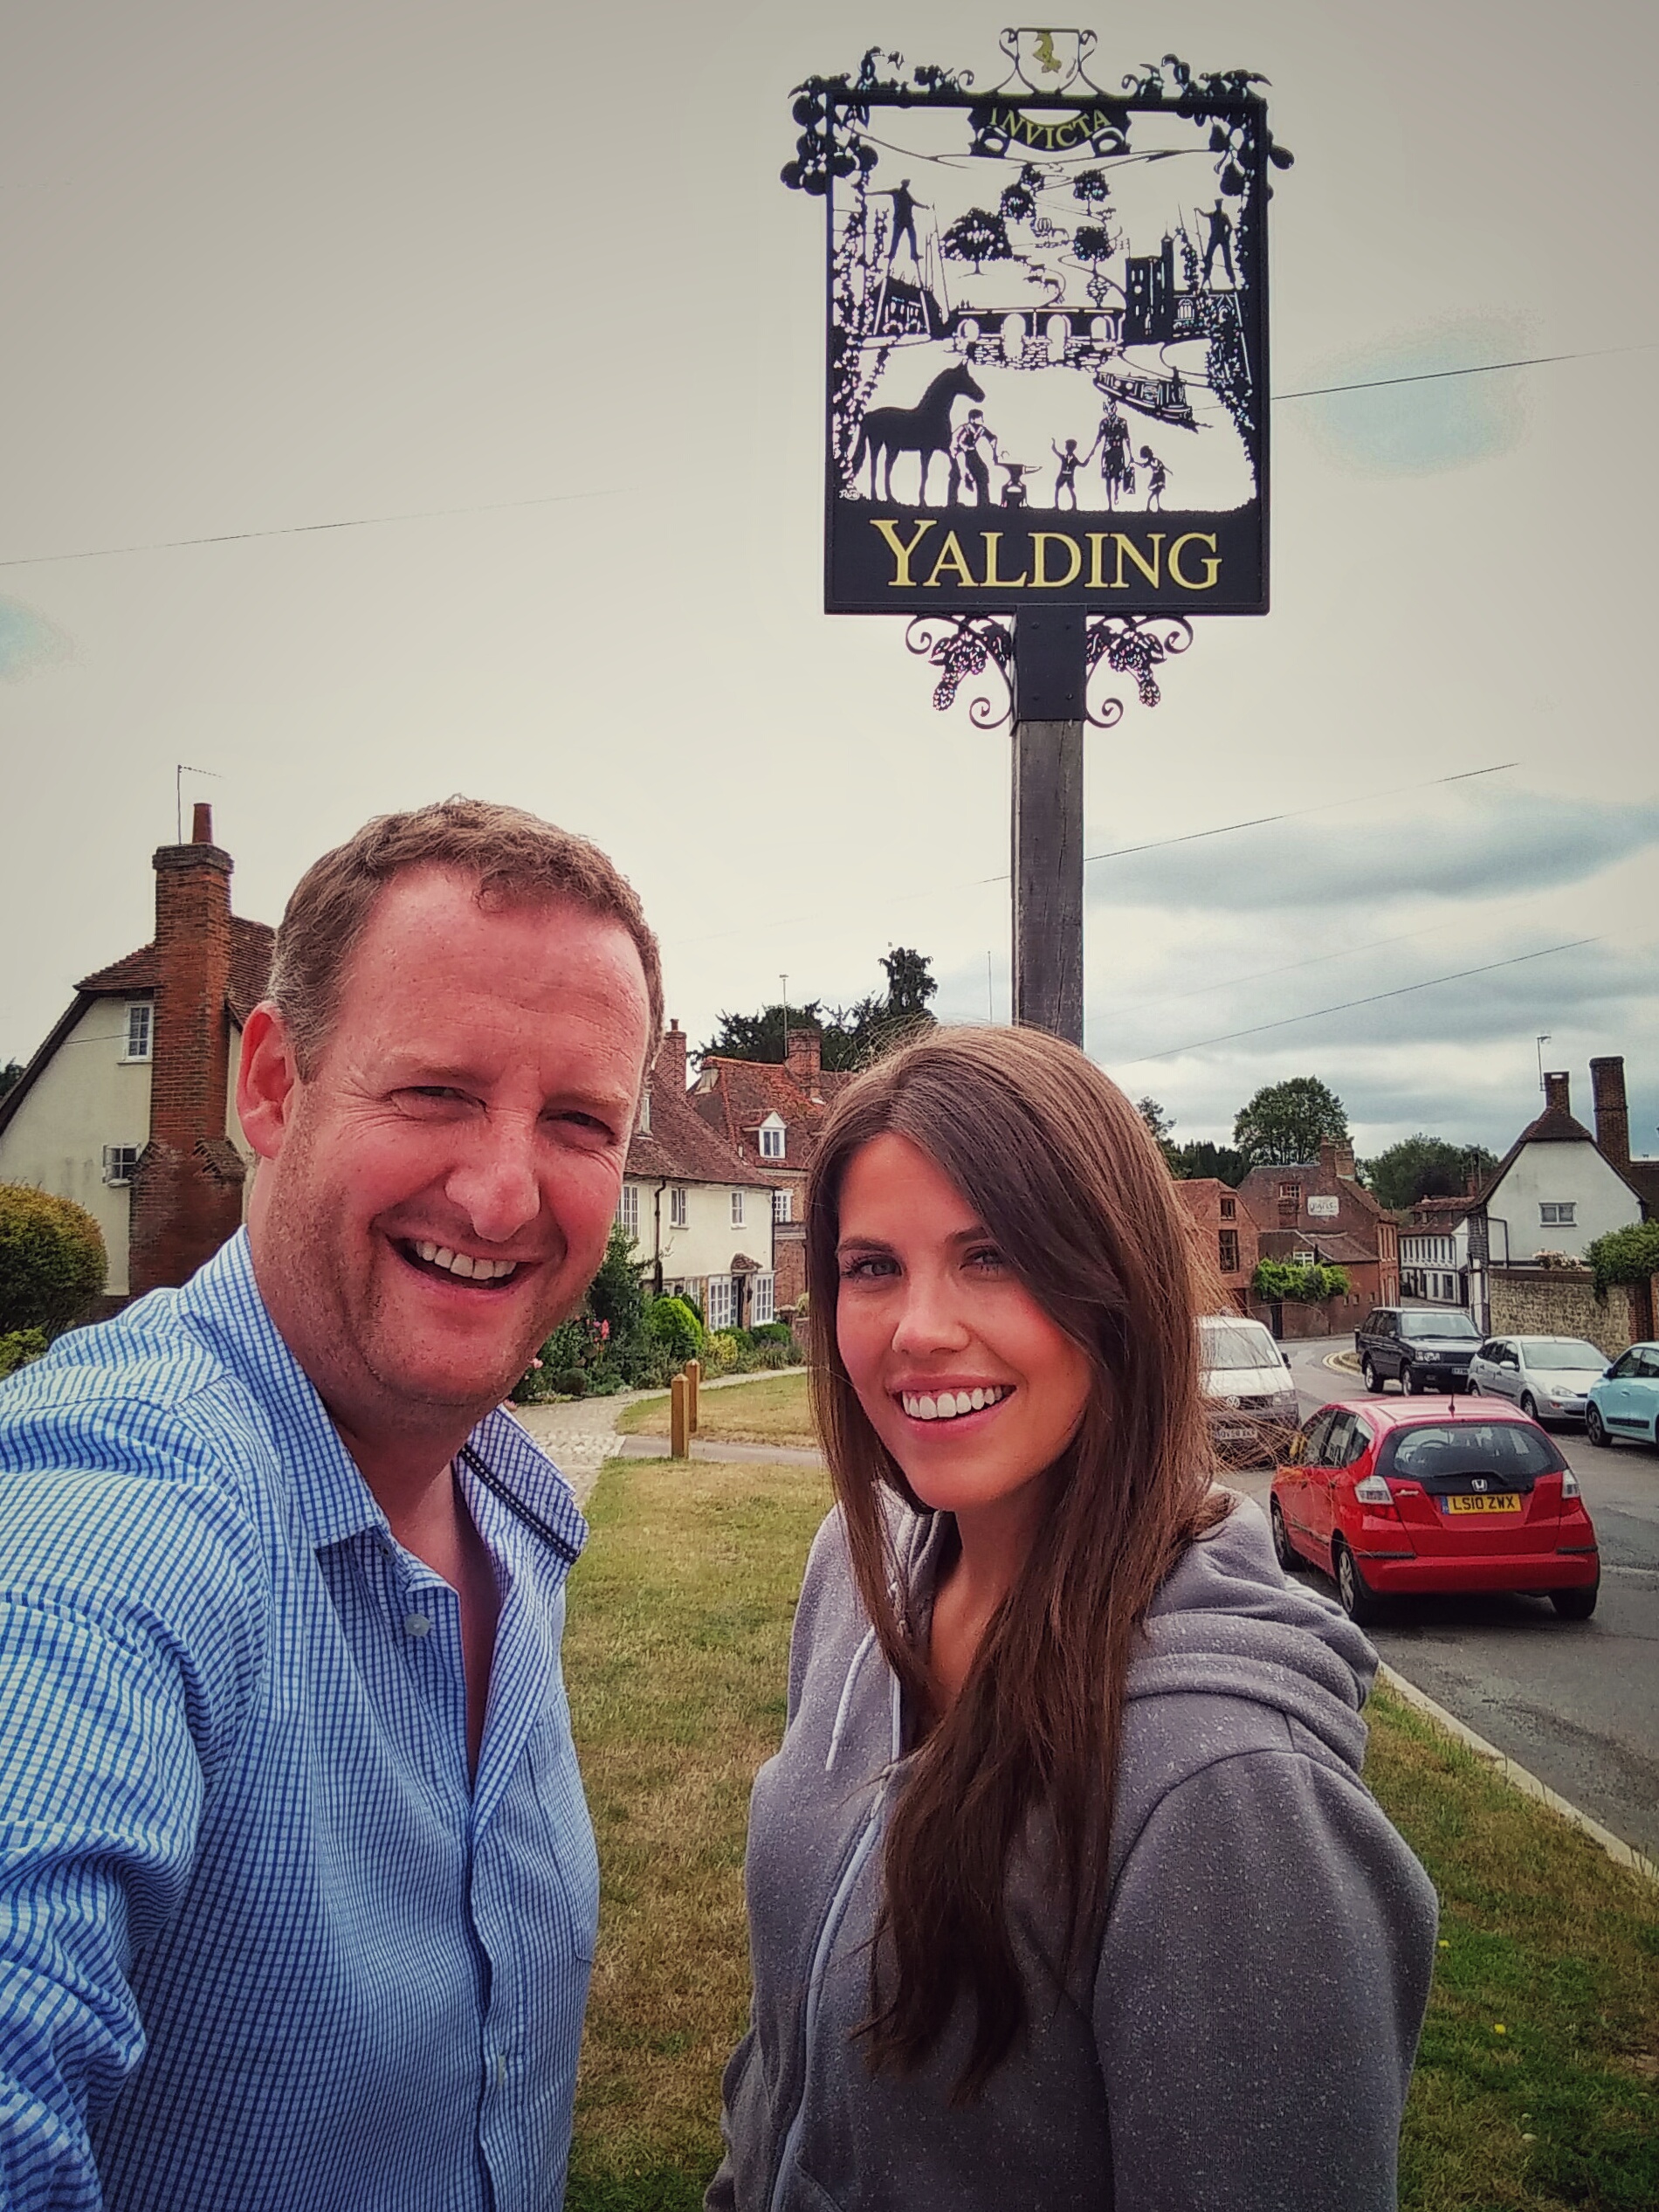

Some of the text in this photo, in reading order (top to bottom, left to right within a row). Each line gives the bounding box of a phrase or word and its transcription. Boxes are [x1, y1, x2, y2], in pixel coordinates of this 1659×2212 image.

[989, 107, 1112, 149] INVICTA
[870, 519, 1222, 589] YALDING
[1452, 1497, 1484, 1511] LS10
[1488, 1495, 1516, 1510] ZWX
